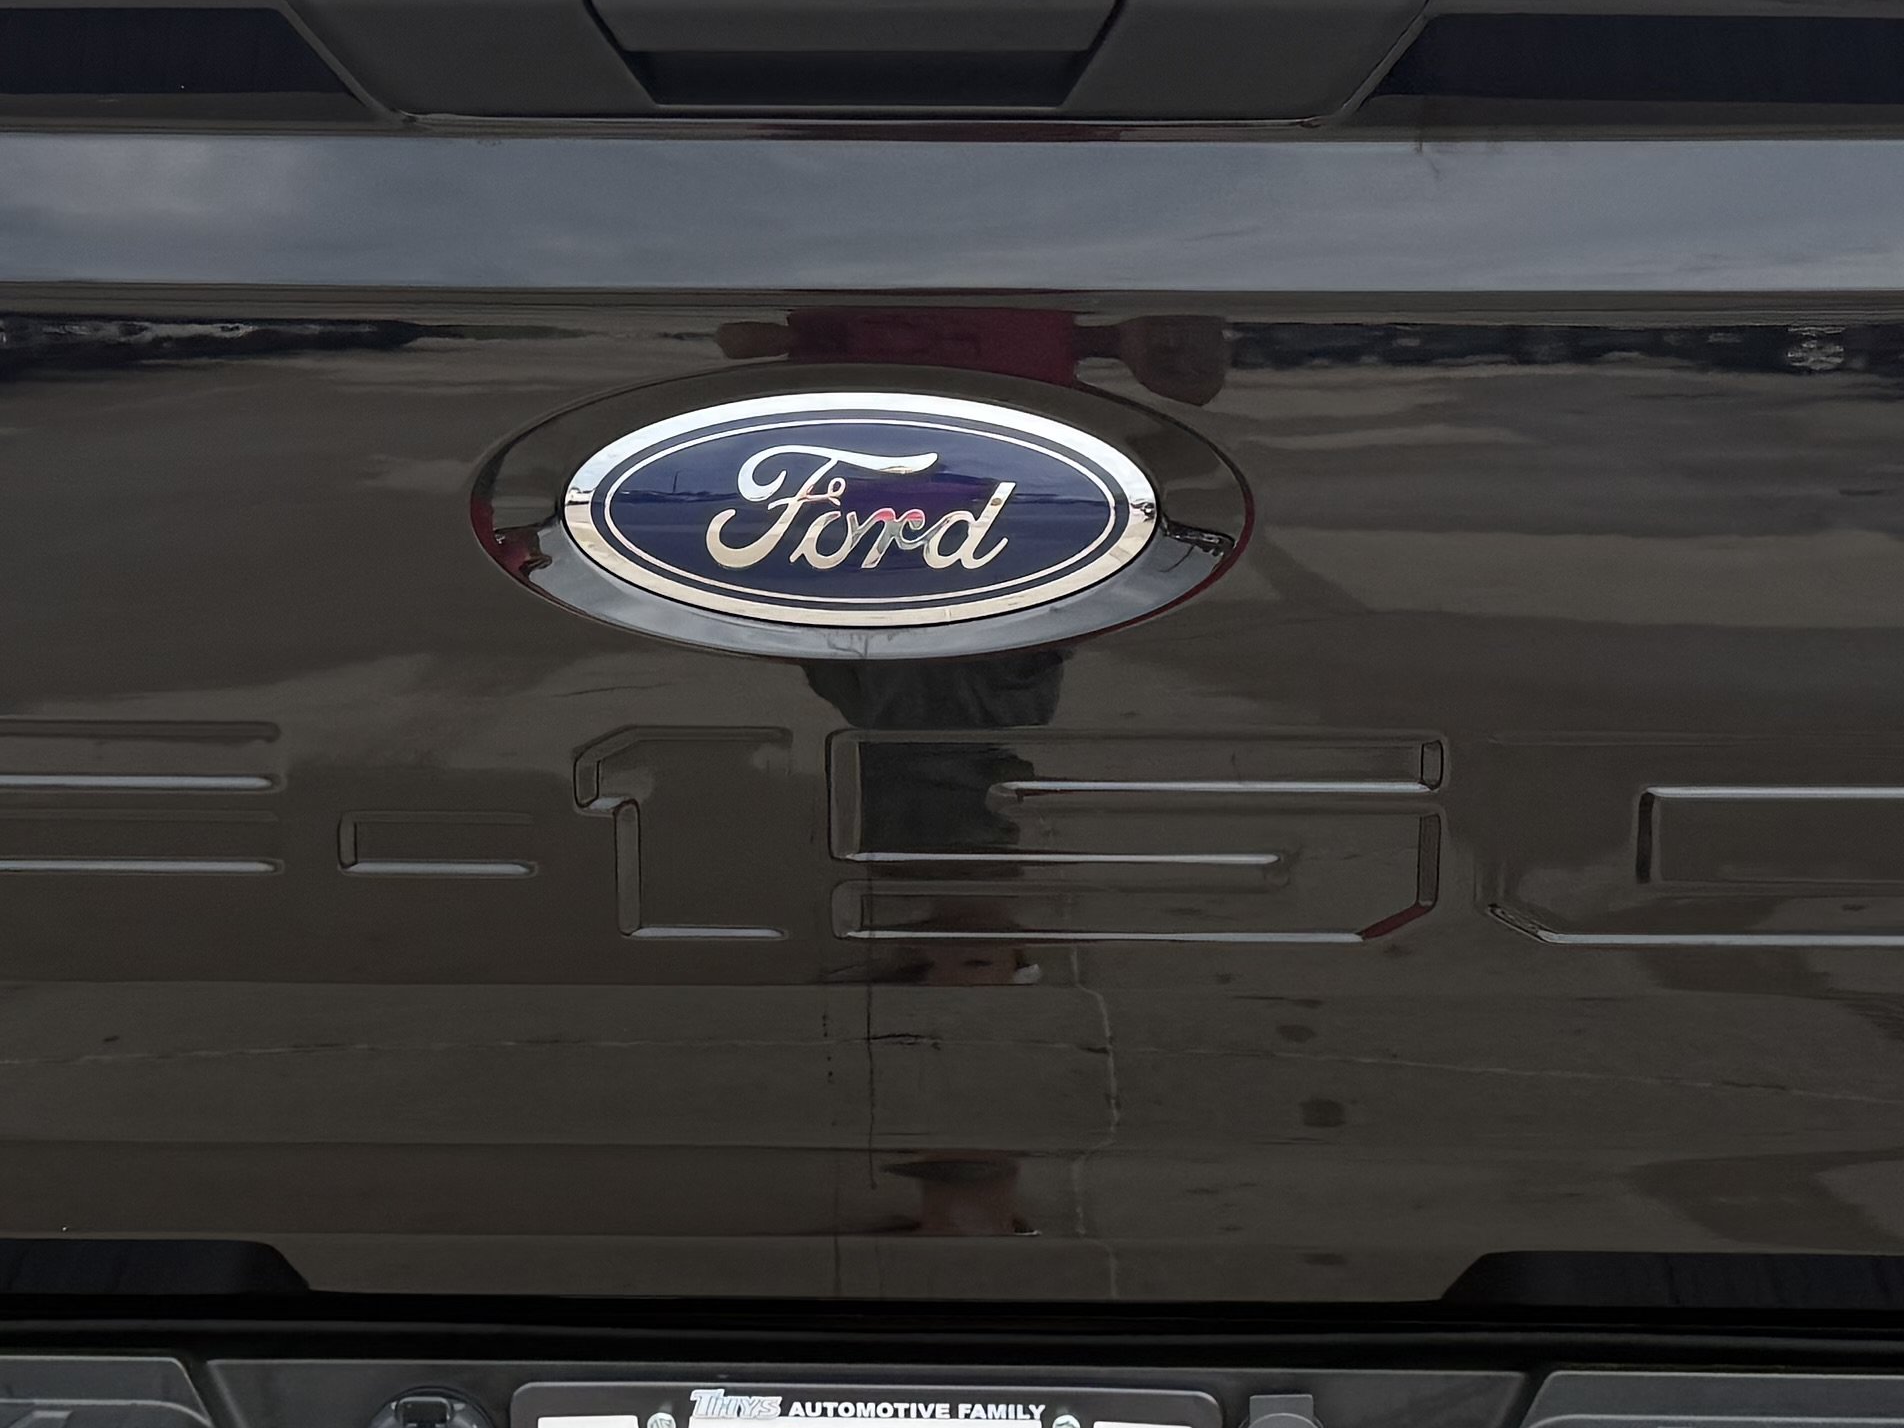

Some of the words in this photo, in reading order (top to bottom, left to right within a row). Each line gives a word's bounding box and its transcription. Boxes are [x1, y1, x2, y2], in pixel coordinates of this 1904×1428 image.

[705, 444, 1015, 570] Ford
[690, 1389, 782, 1420] THYS
[789, 1401, 950, 1420] AUTOMOTIVE
[957, 1403, 1046, 1420] FAMILY
